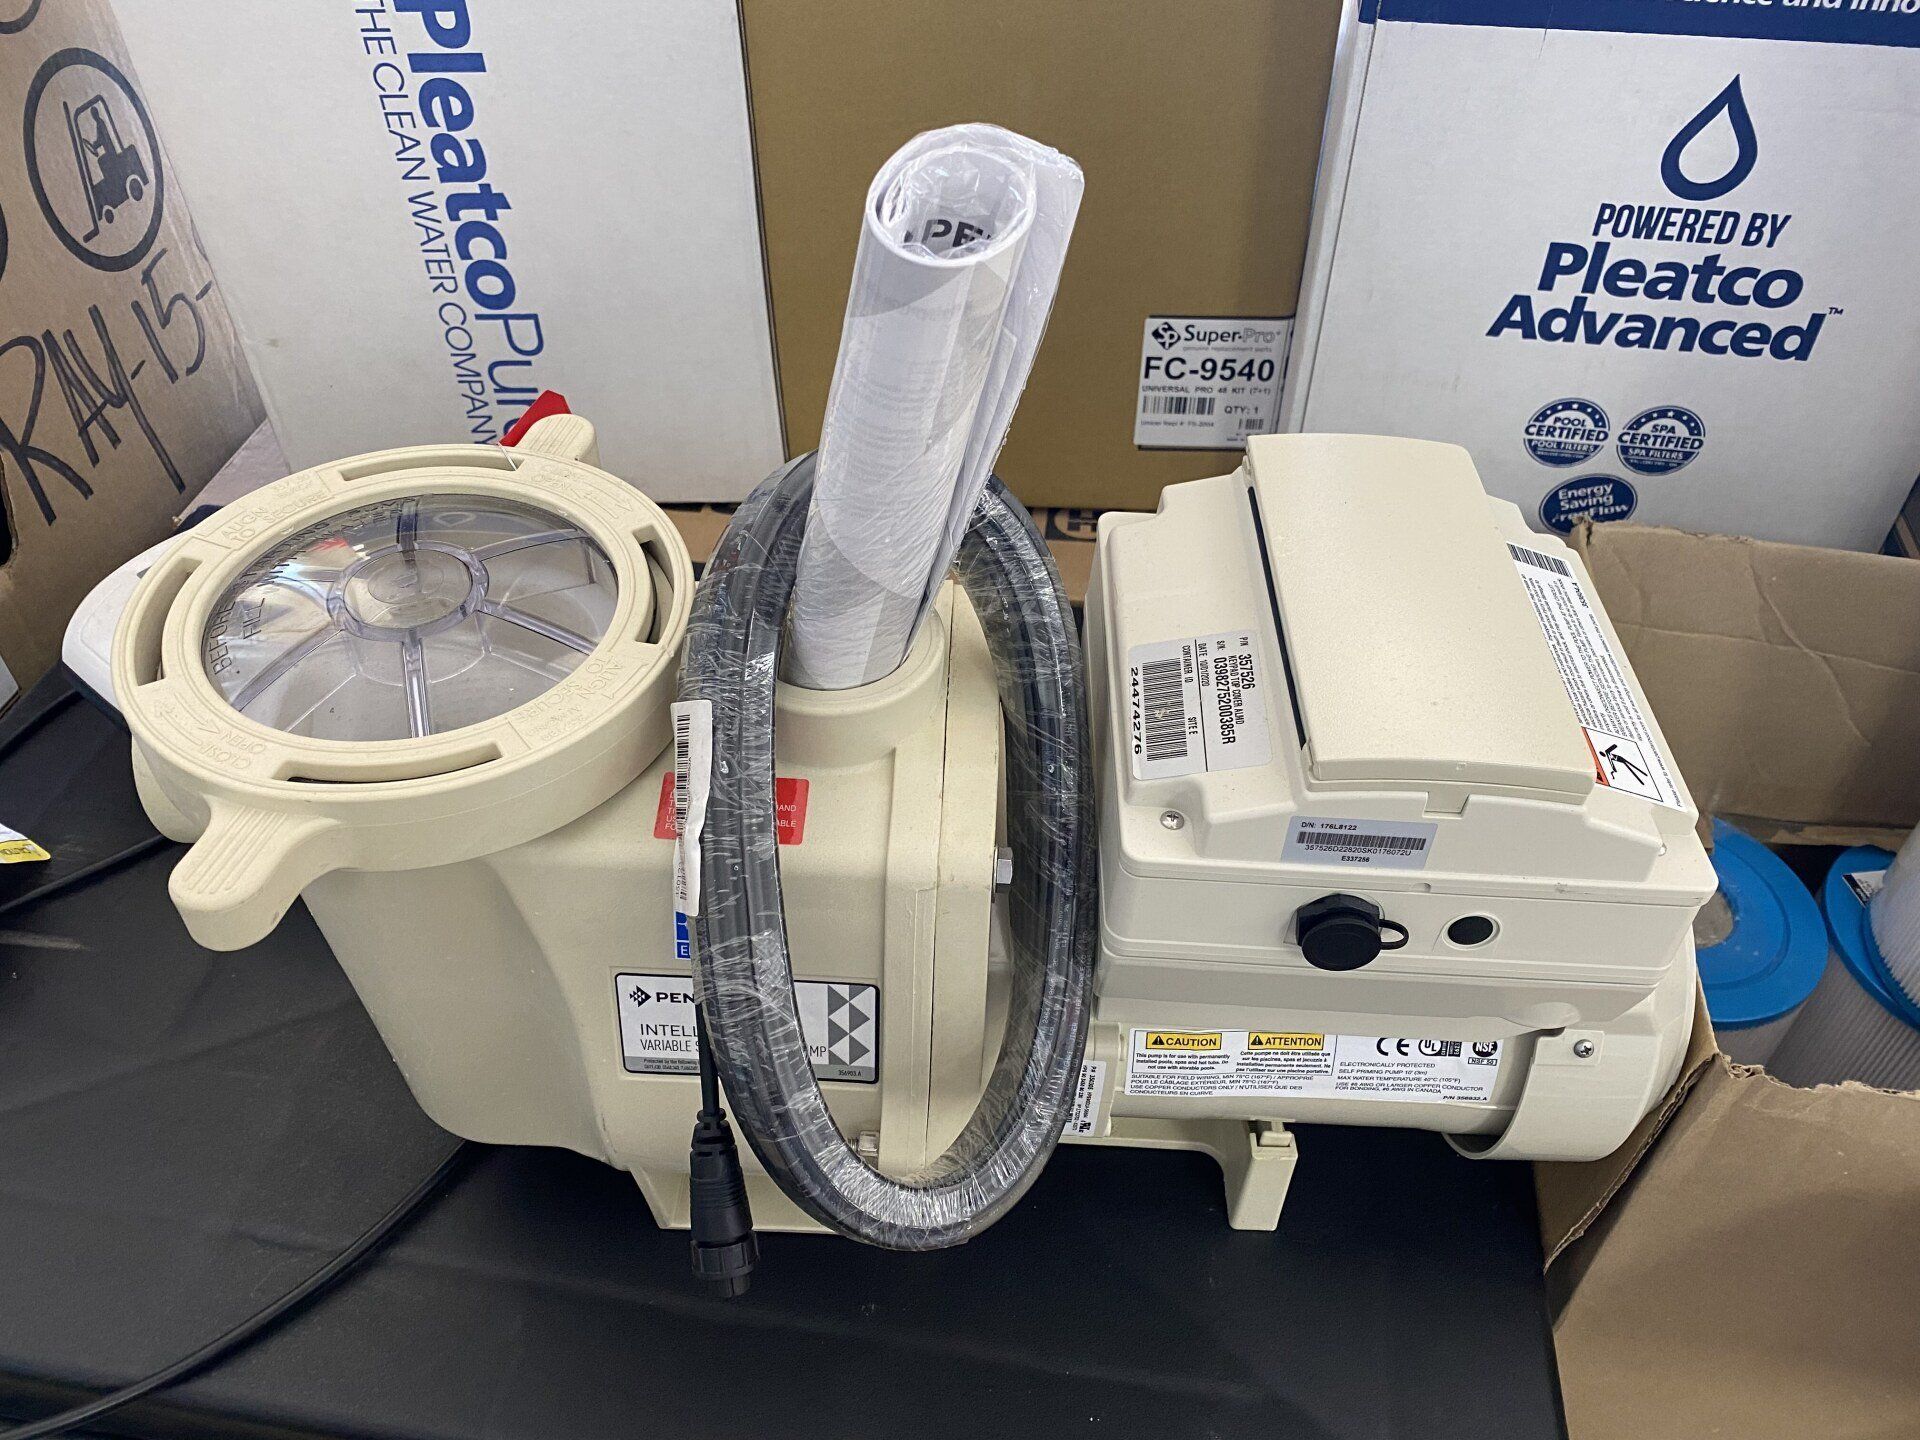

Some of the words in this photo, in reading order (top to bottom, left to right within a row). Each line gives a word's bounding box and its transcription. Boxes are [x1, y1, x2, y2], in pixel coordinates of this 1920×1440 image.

[373, 63, 430, 180] CLEAN
[408, 191, 458, 293] WATER
[1592, 203, 1741, 246] POWERED
[1742, 213, 1792, 248] BY
[1537, 241, 1804, 309] Pleatco
[1485, 295, 1827, 361] Advanced
[1143, 356, 1275, 382] FC-9540
[1142, 385, 1190, 394] UNIVERSAL
[1195, 386, 1213, 394] PRO
[1231, 387, 1245, 395] KIT
[1224, 405, 1250, 415] QTY:
[1553, 417, 1587, 427] POOL
[1650, 424, 1676, 435] SPA
[1524, 424, 1609, 442] CERTIFIED
[1617, 431, 1704, 450] CERTIFIED
[1531, 440, 1559, 449] POOL
[1560, 442, 1595, 452] FILTERS
[1628, 447, 1647, 457] SPA
[1648, 450, 1684, 460] FILTERS
[1558, 483, 1613, 500] Energy
[1560, 494, 1614, 511] Saving
[1182, 645, 1193, 674] CONTAINER
[1228, 655, 1239, 676] KEYPAD
[1238, 653, 1256, 690] 357526
[1230, 677, 1240, 688] TOP
[1213, 656, 1236, 745] 0398275200385R
[1232, 689, 1243, 708] COVER
[1130, 666, 1142, 755] 24474276
[640, 1039, 693, 1052] VARIABLE
[1166, 1037, 1217, 1047] CAUTION
[1265, 1037, 1322, 1047] ATTENTION
[1476, 1042, 1495, 1053] NSF
